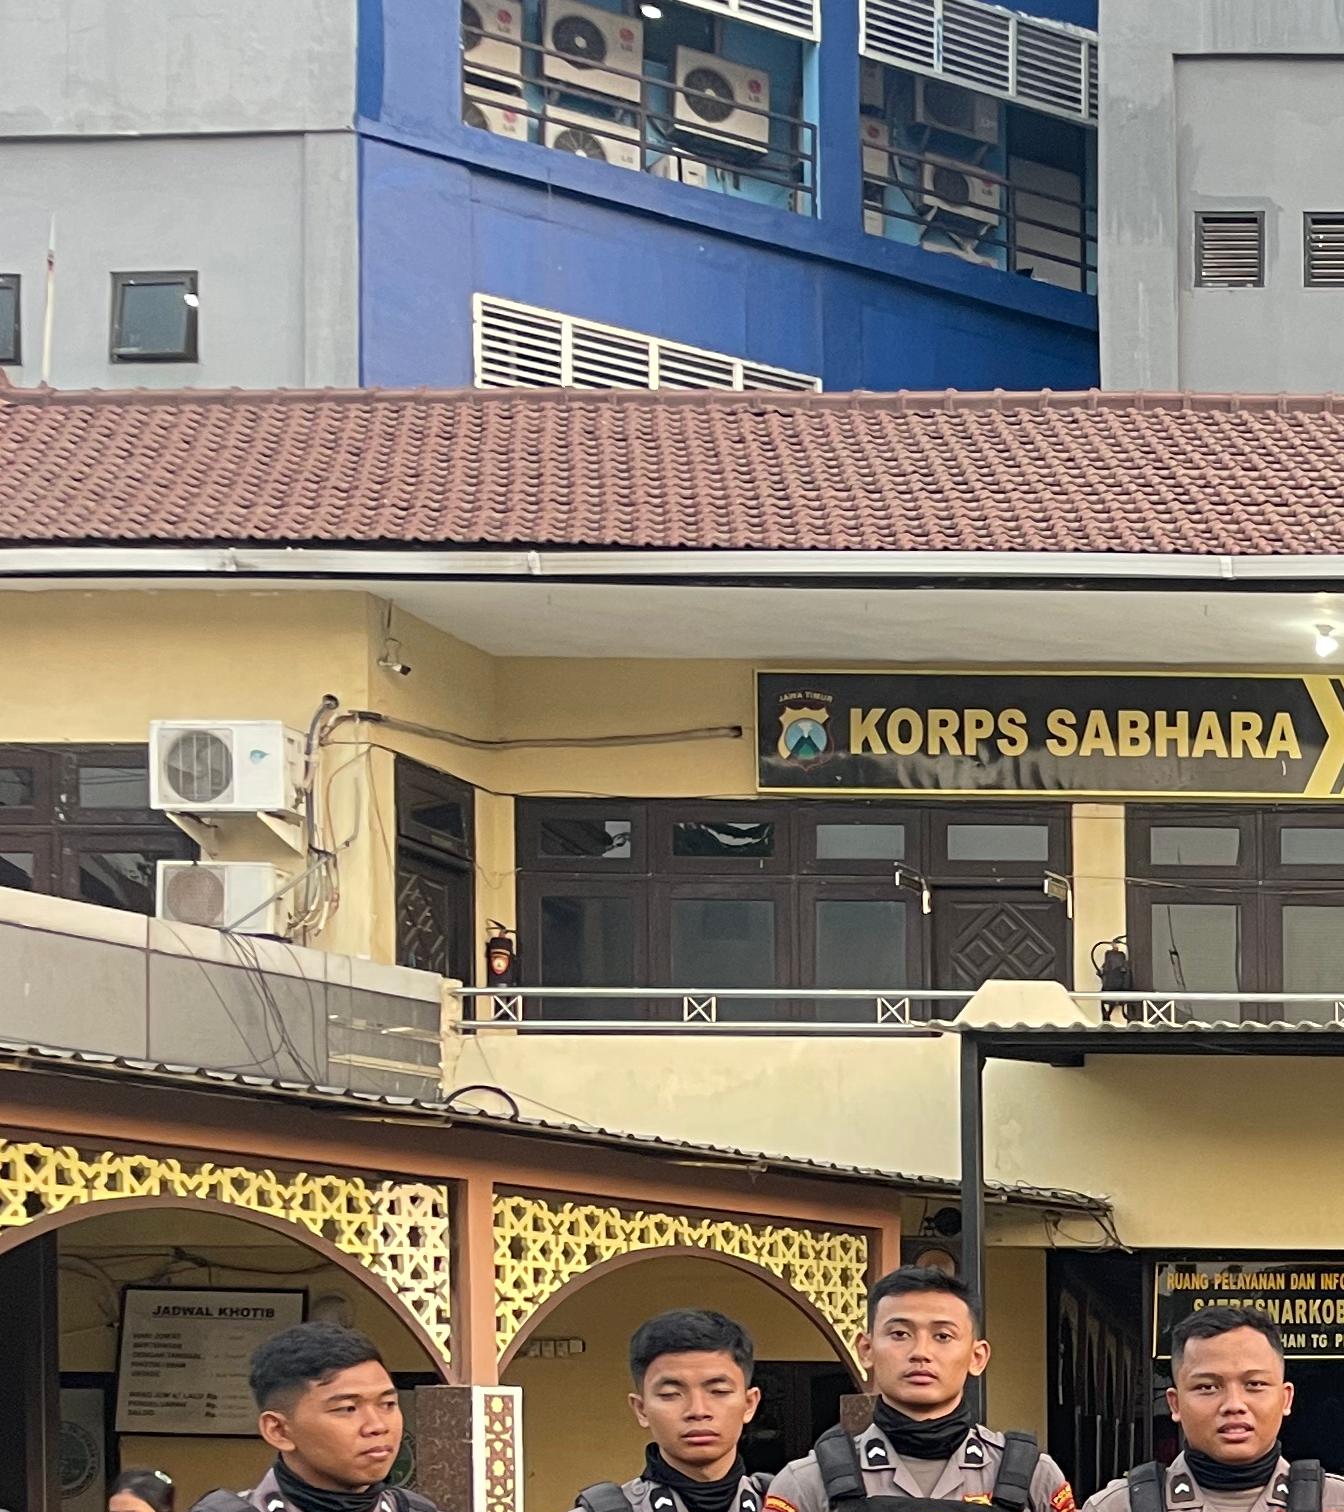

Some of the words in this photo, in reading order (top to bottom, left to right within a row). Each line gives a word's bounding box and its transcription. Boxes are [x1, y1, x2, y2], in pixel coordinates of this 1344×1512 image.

[849, 708, 1028, 758] KORPS
[1046, 710, 1303, 760] SABHARA
[1167, 1273, 1209, 1290] RUANG
[1213, 1273, 1285, 1290] PELAYANAN
[1290, 1273, 1316, 1290] DAN
[152, 1305, 213, 1318] JADWAL
[218, 1307, 275, 1318] KHOTIB
[1312, 1334, 1327, 1348] TG
